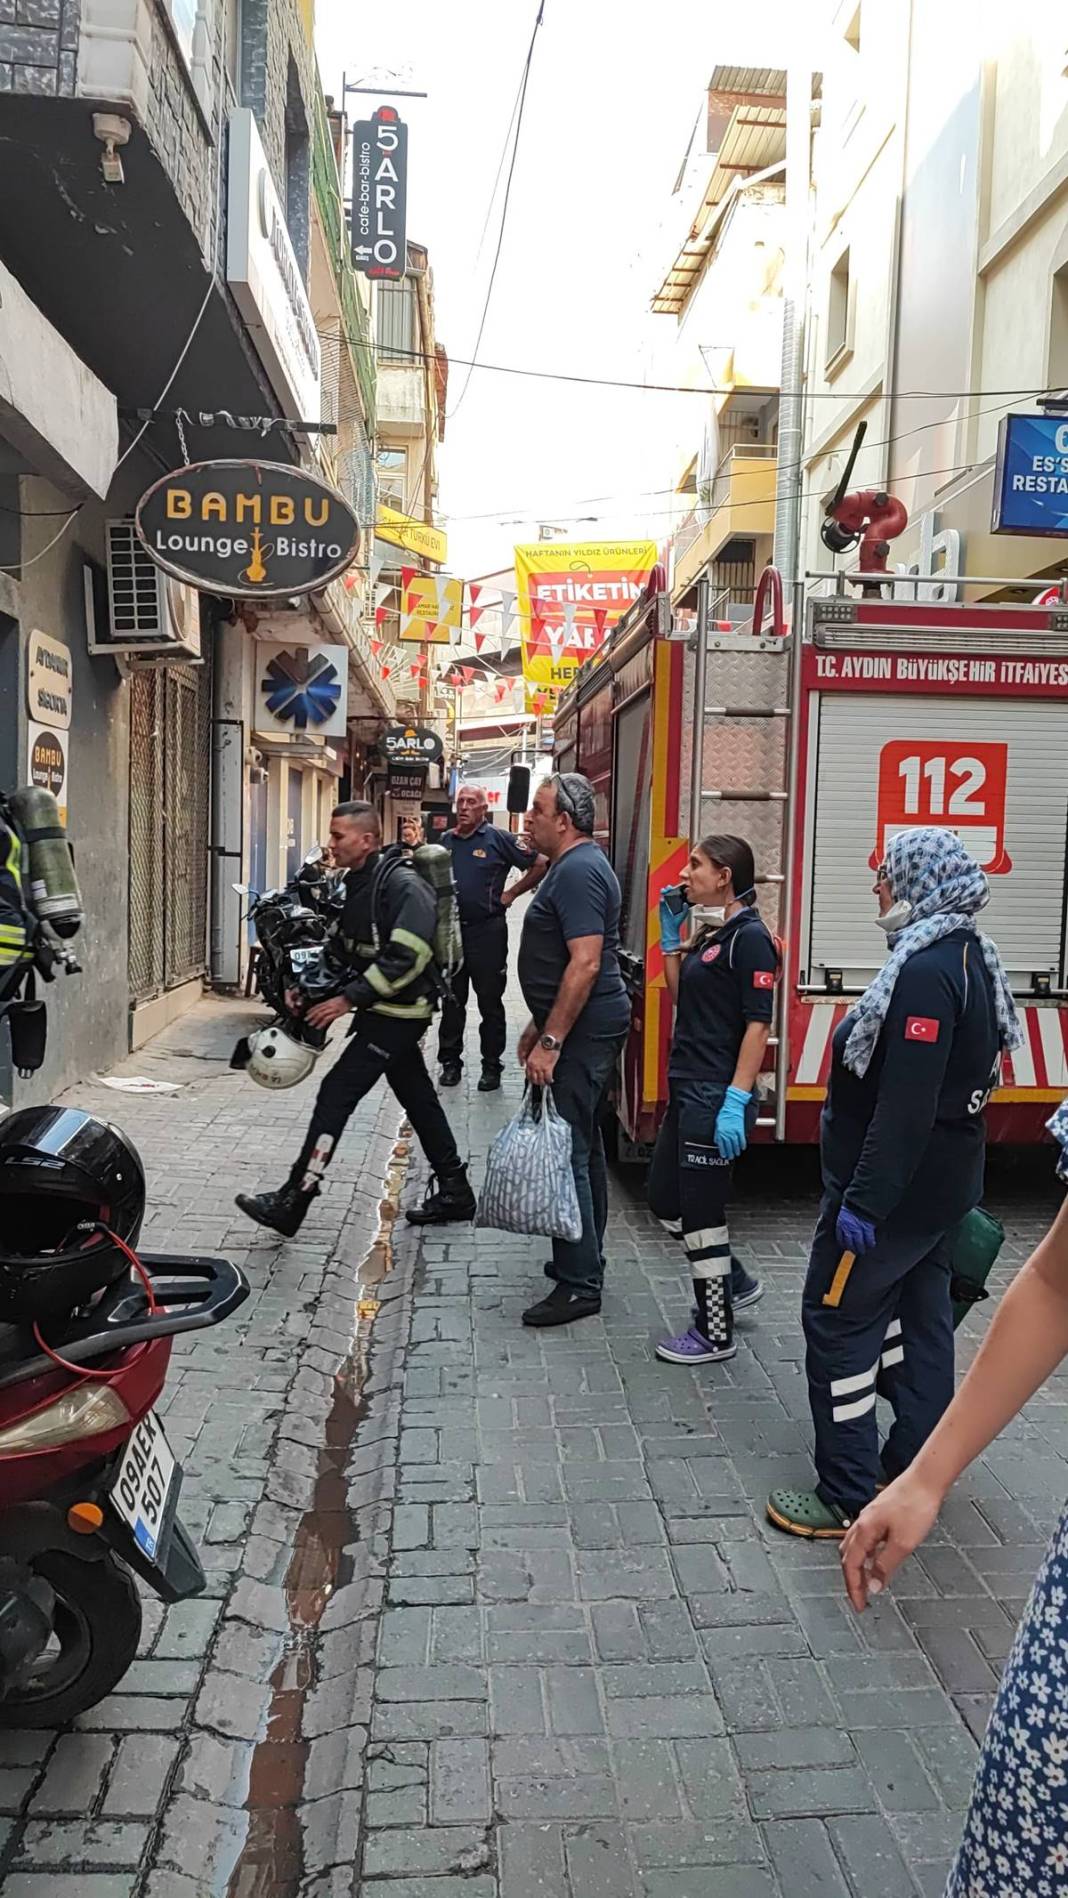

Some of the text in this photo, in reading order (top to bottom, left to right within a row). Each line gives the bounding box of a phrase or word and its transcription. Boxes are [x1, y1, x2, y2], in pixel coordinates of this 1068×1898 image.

[166, 489, 329, 527] BAMBU
[156, 530, 342, 558] Lounge Bistro
[526, 546, 649, 558] HAFTANIN YILDIZ ÜRÜNLERİ
[841, 657, 892, 680] AYDIN
[385, 736, 436, 750] 5ARLO
[34, 746, 62, 767] BAMBU
[898, 756, 987, 816] 112
[140, 1455, 166, 1526] 507
